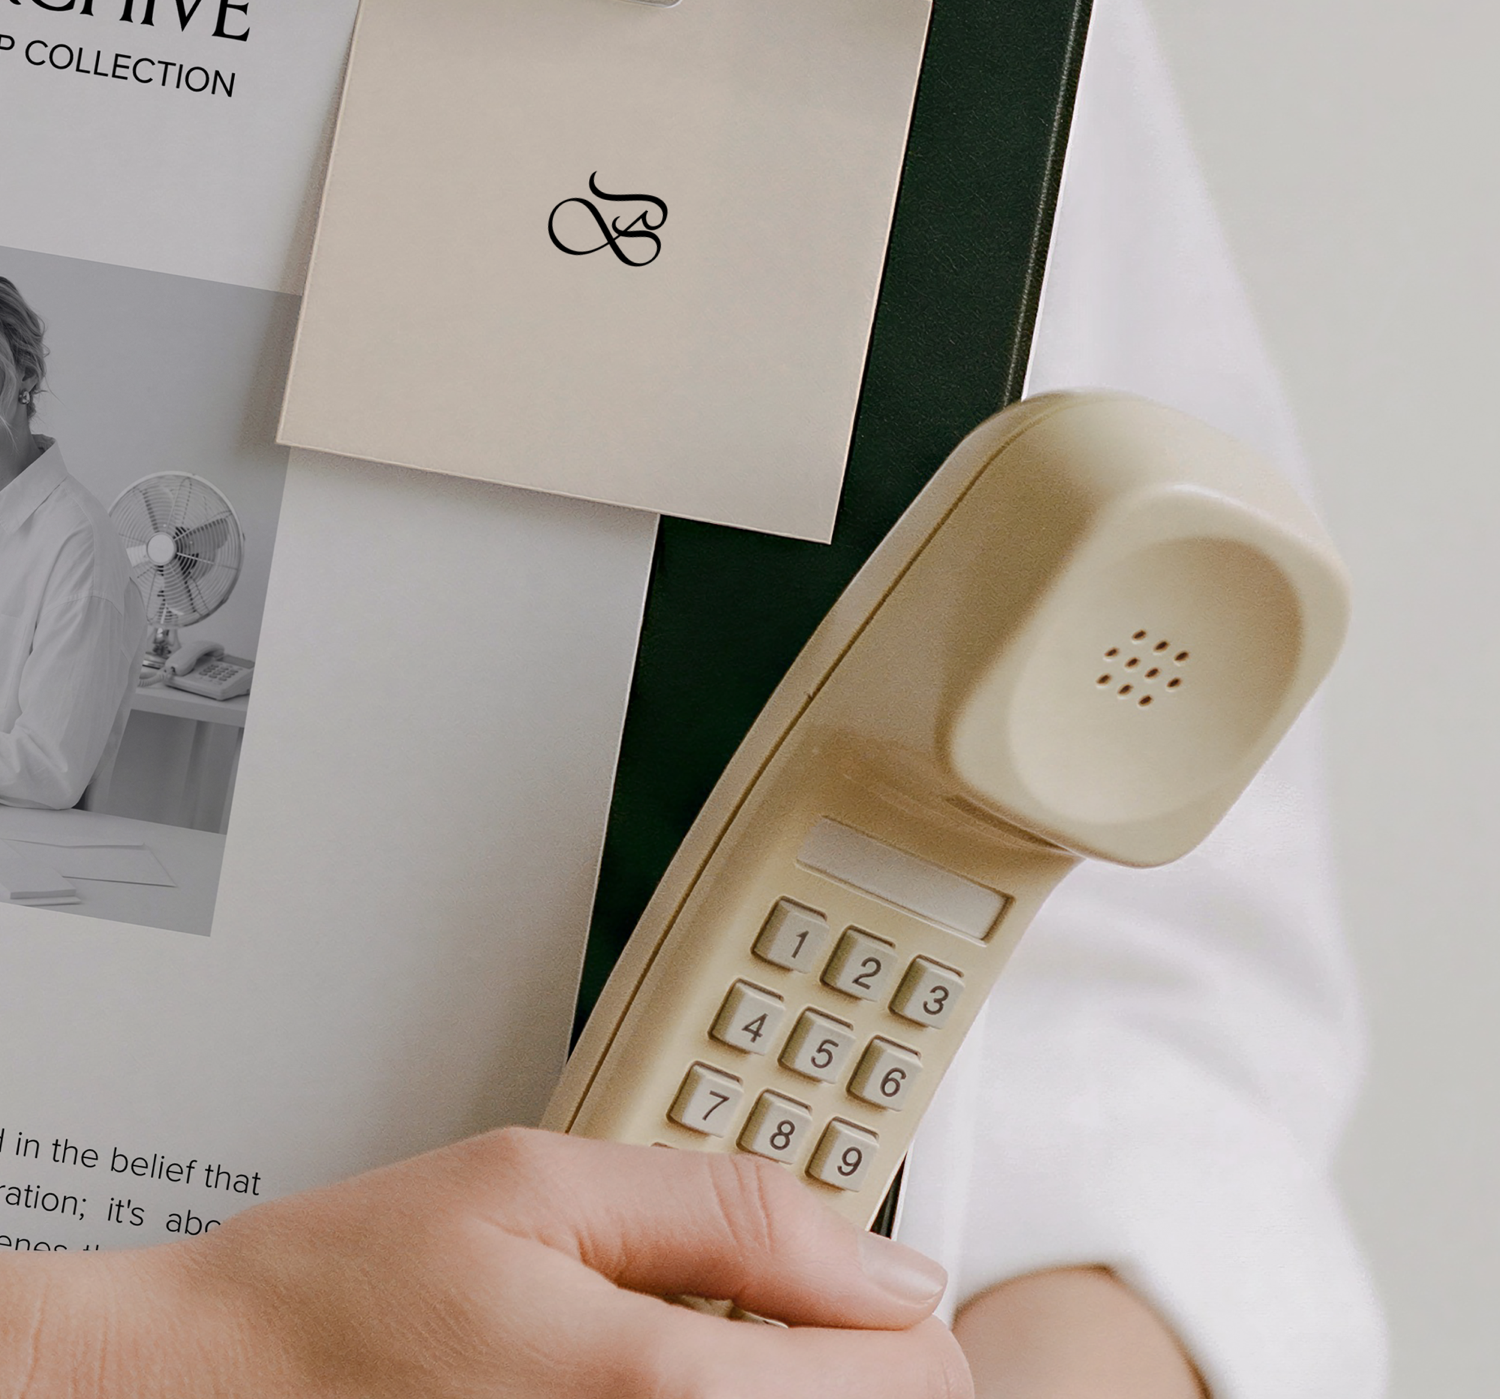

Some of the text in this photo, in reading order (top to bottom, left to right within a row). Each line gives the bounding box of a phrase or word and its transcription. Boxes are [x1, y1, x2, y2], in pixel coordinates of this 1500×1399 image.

[24, 39, 236, 98] COLLECTION
[791, 930, 950, 1016] 1 2 3
[741, 1013, 907, 1098] 4 5 6
[15, 1131, 40, 1159] in
[51, 1138, 99, 1169] the
[110, 1146, 198, 1185] belief
[204, 1163, 262, 1196] that
[702, 1090, 863, 1177] 7 8 9
[107, 1197, 145, 1227] it's
